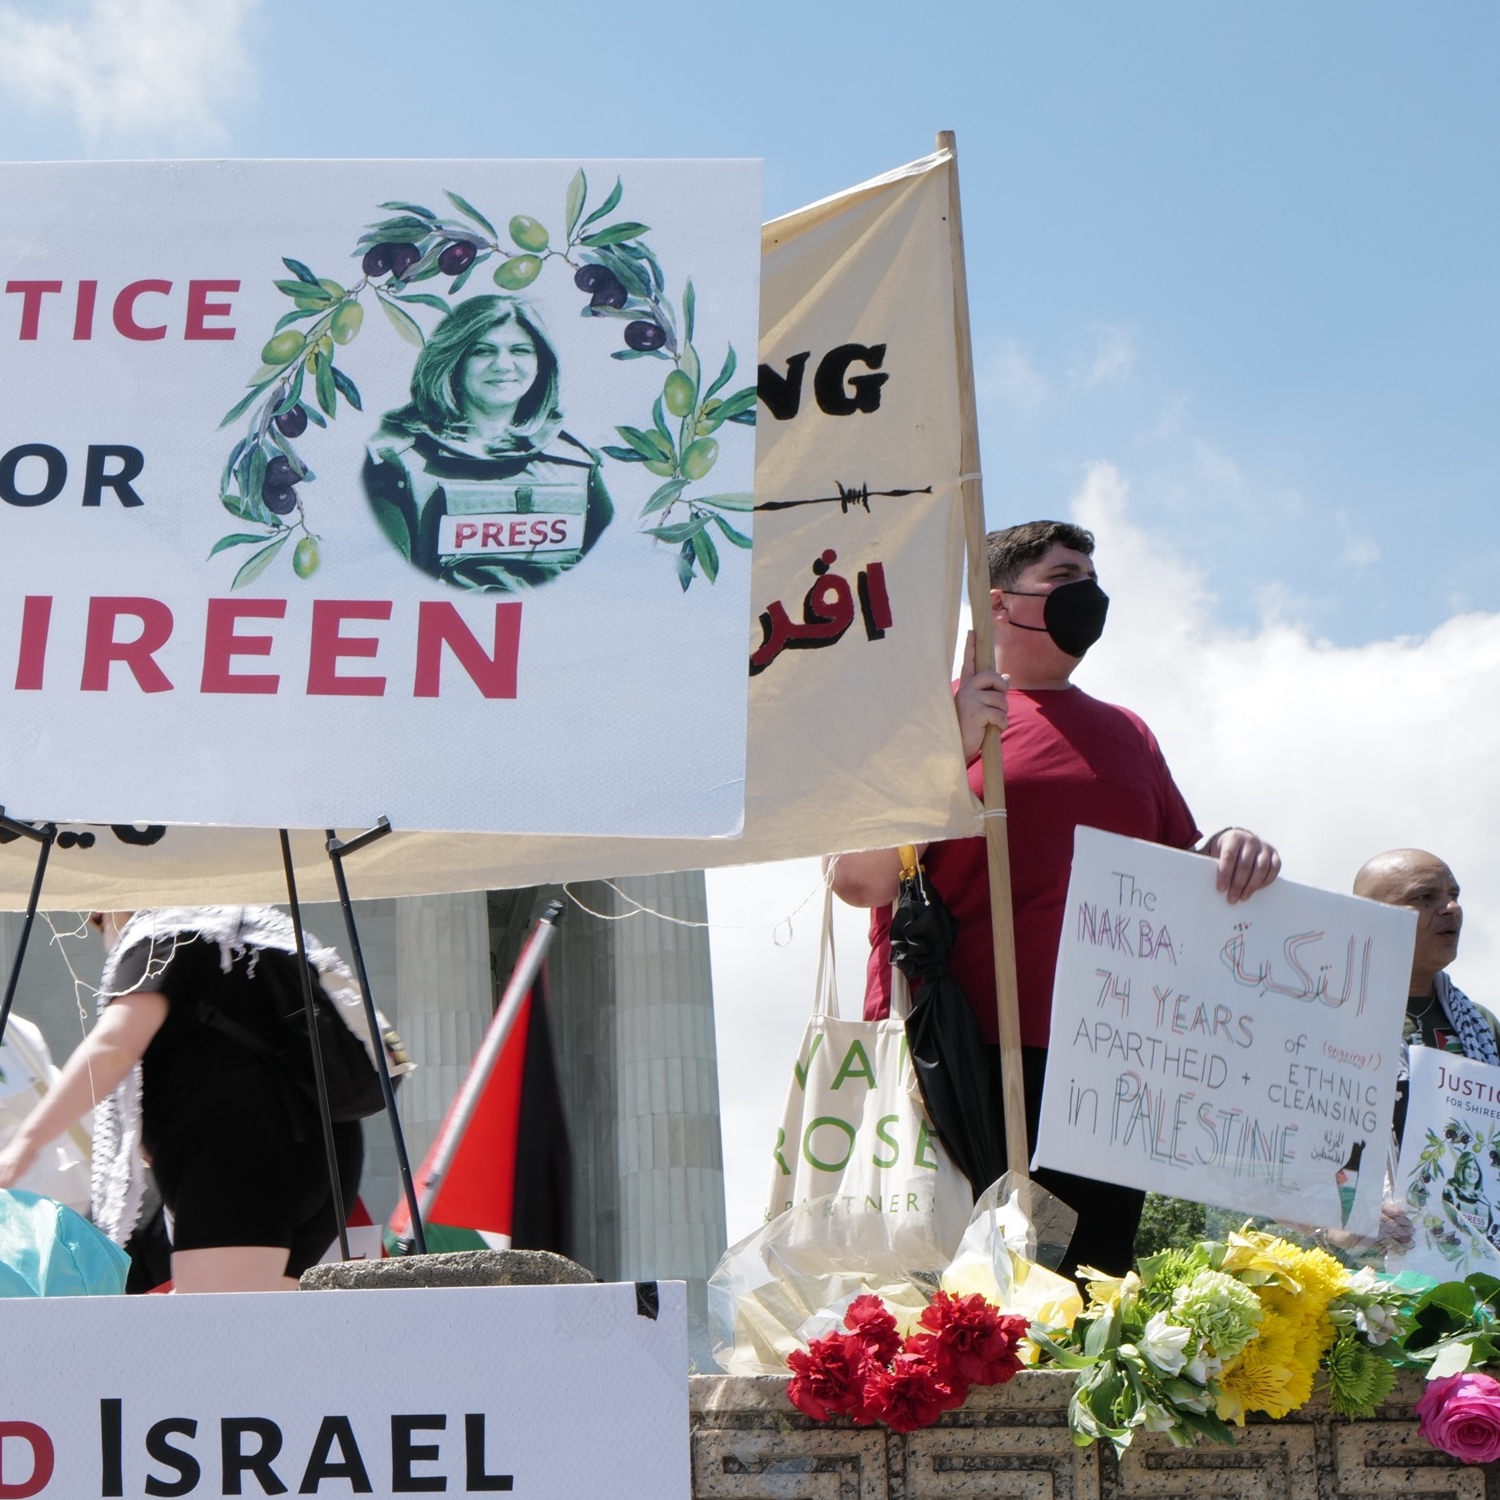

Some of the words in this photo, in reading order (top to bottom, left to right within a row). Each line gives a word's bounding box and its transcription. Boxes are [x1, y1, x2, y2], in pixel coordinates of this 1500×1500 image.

[454, 519, 568, 549] PRESS
[1111, 871, 1156, 912] The
[1095, 968, 1131, 1019] 74
[1152, 984, 1254, 1049] YEARS
[1284, 1034, 1308, 1055] of
[1073, 1017, 1228, 1089] APARTHEID
[1288, 1063, 1378, 1107] ETHNIC
[1068, 1079, 1098, 1134] in
[1110, 1069, 1301, 1194] PALESTINE
[1268, 1084, 1377, 1133] CLEANSING
[1446, 1096, 1463, 1110] FOR
[100, 1398, 514, 1497] ISRAEL
